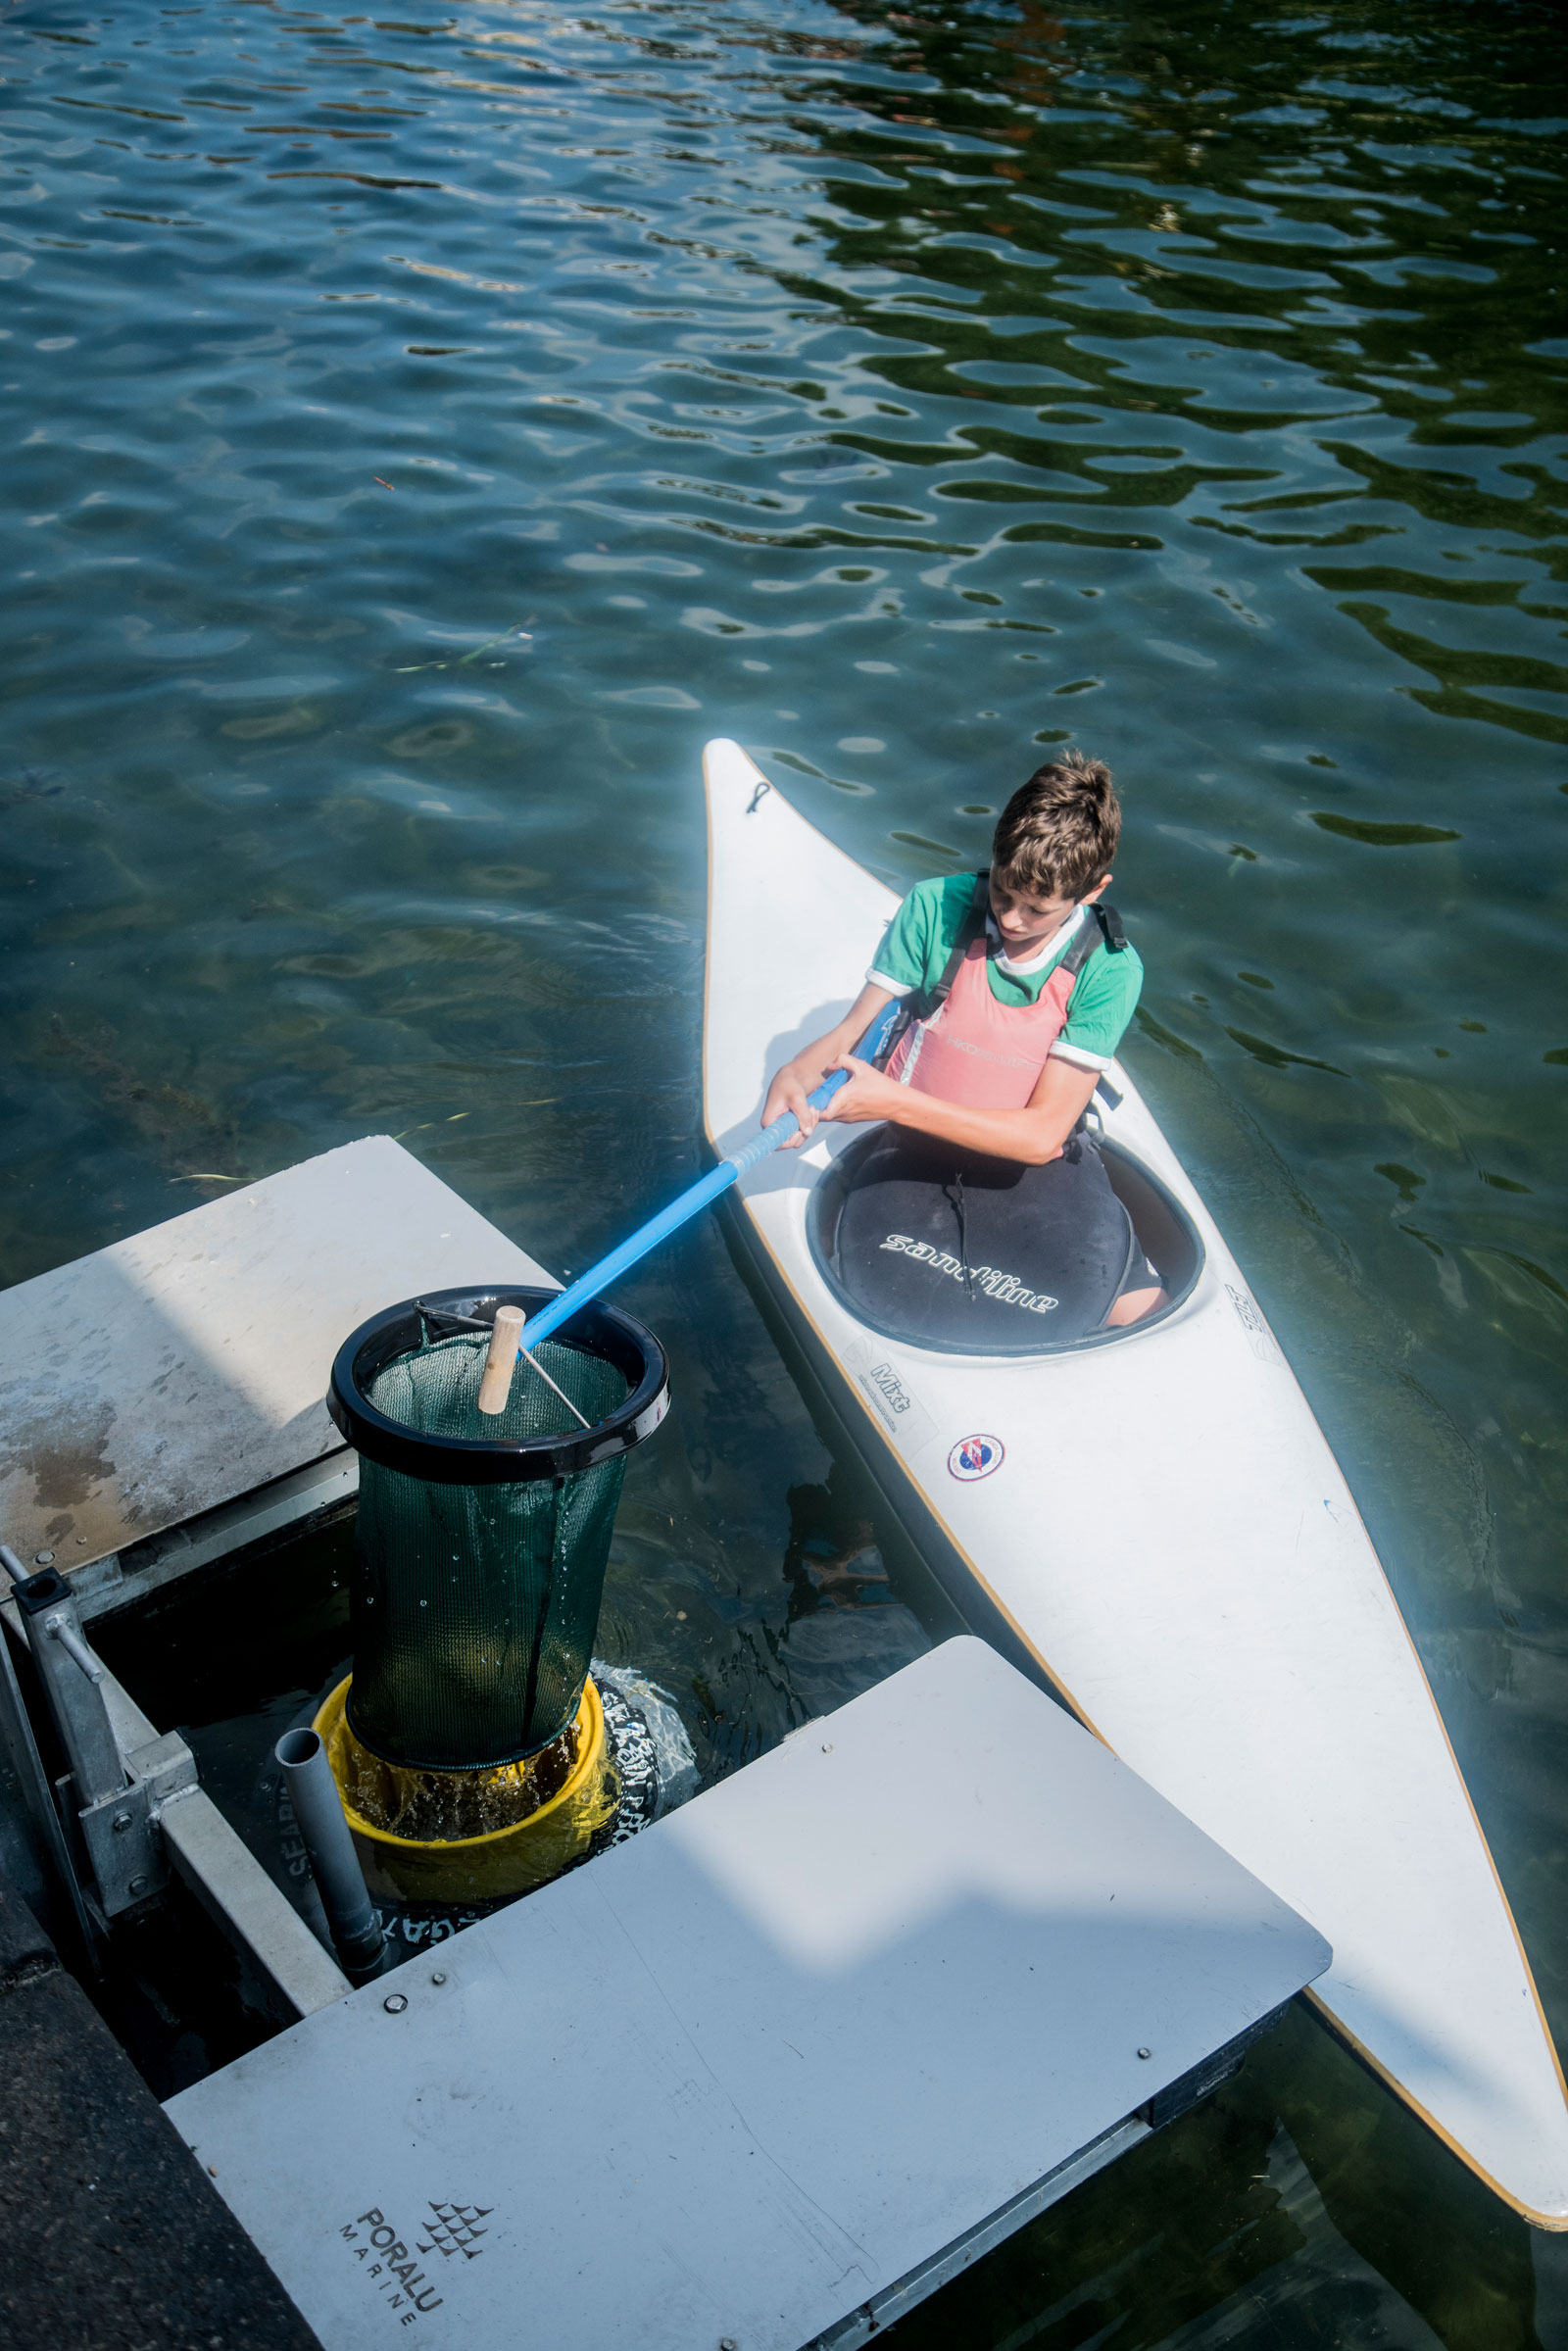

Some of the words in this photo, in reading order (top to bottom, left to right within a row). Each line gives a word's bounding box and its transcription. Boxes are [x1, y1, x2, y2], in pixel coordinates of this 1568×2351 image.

[870, 1363, 910, 1414] Mixt
[339, 2224, 416, 2326] MARINE
[357, 2207, 444, 2312] PORALU
